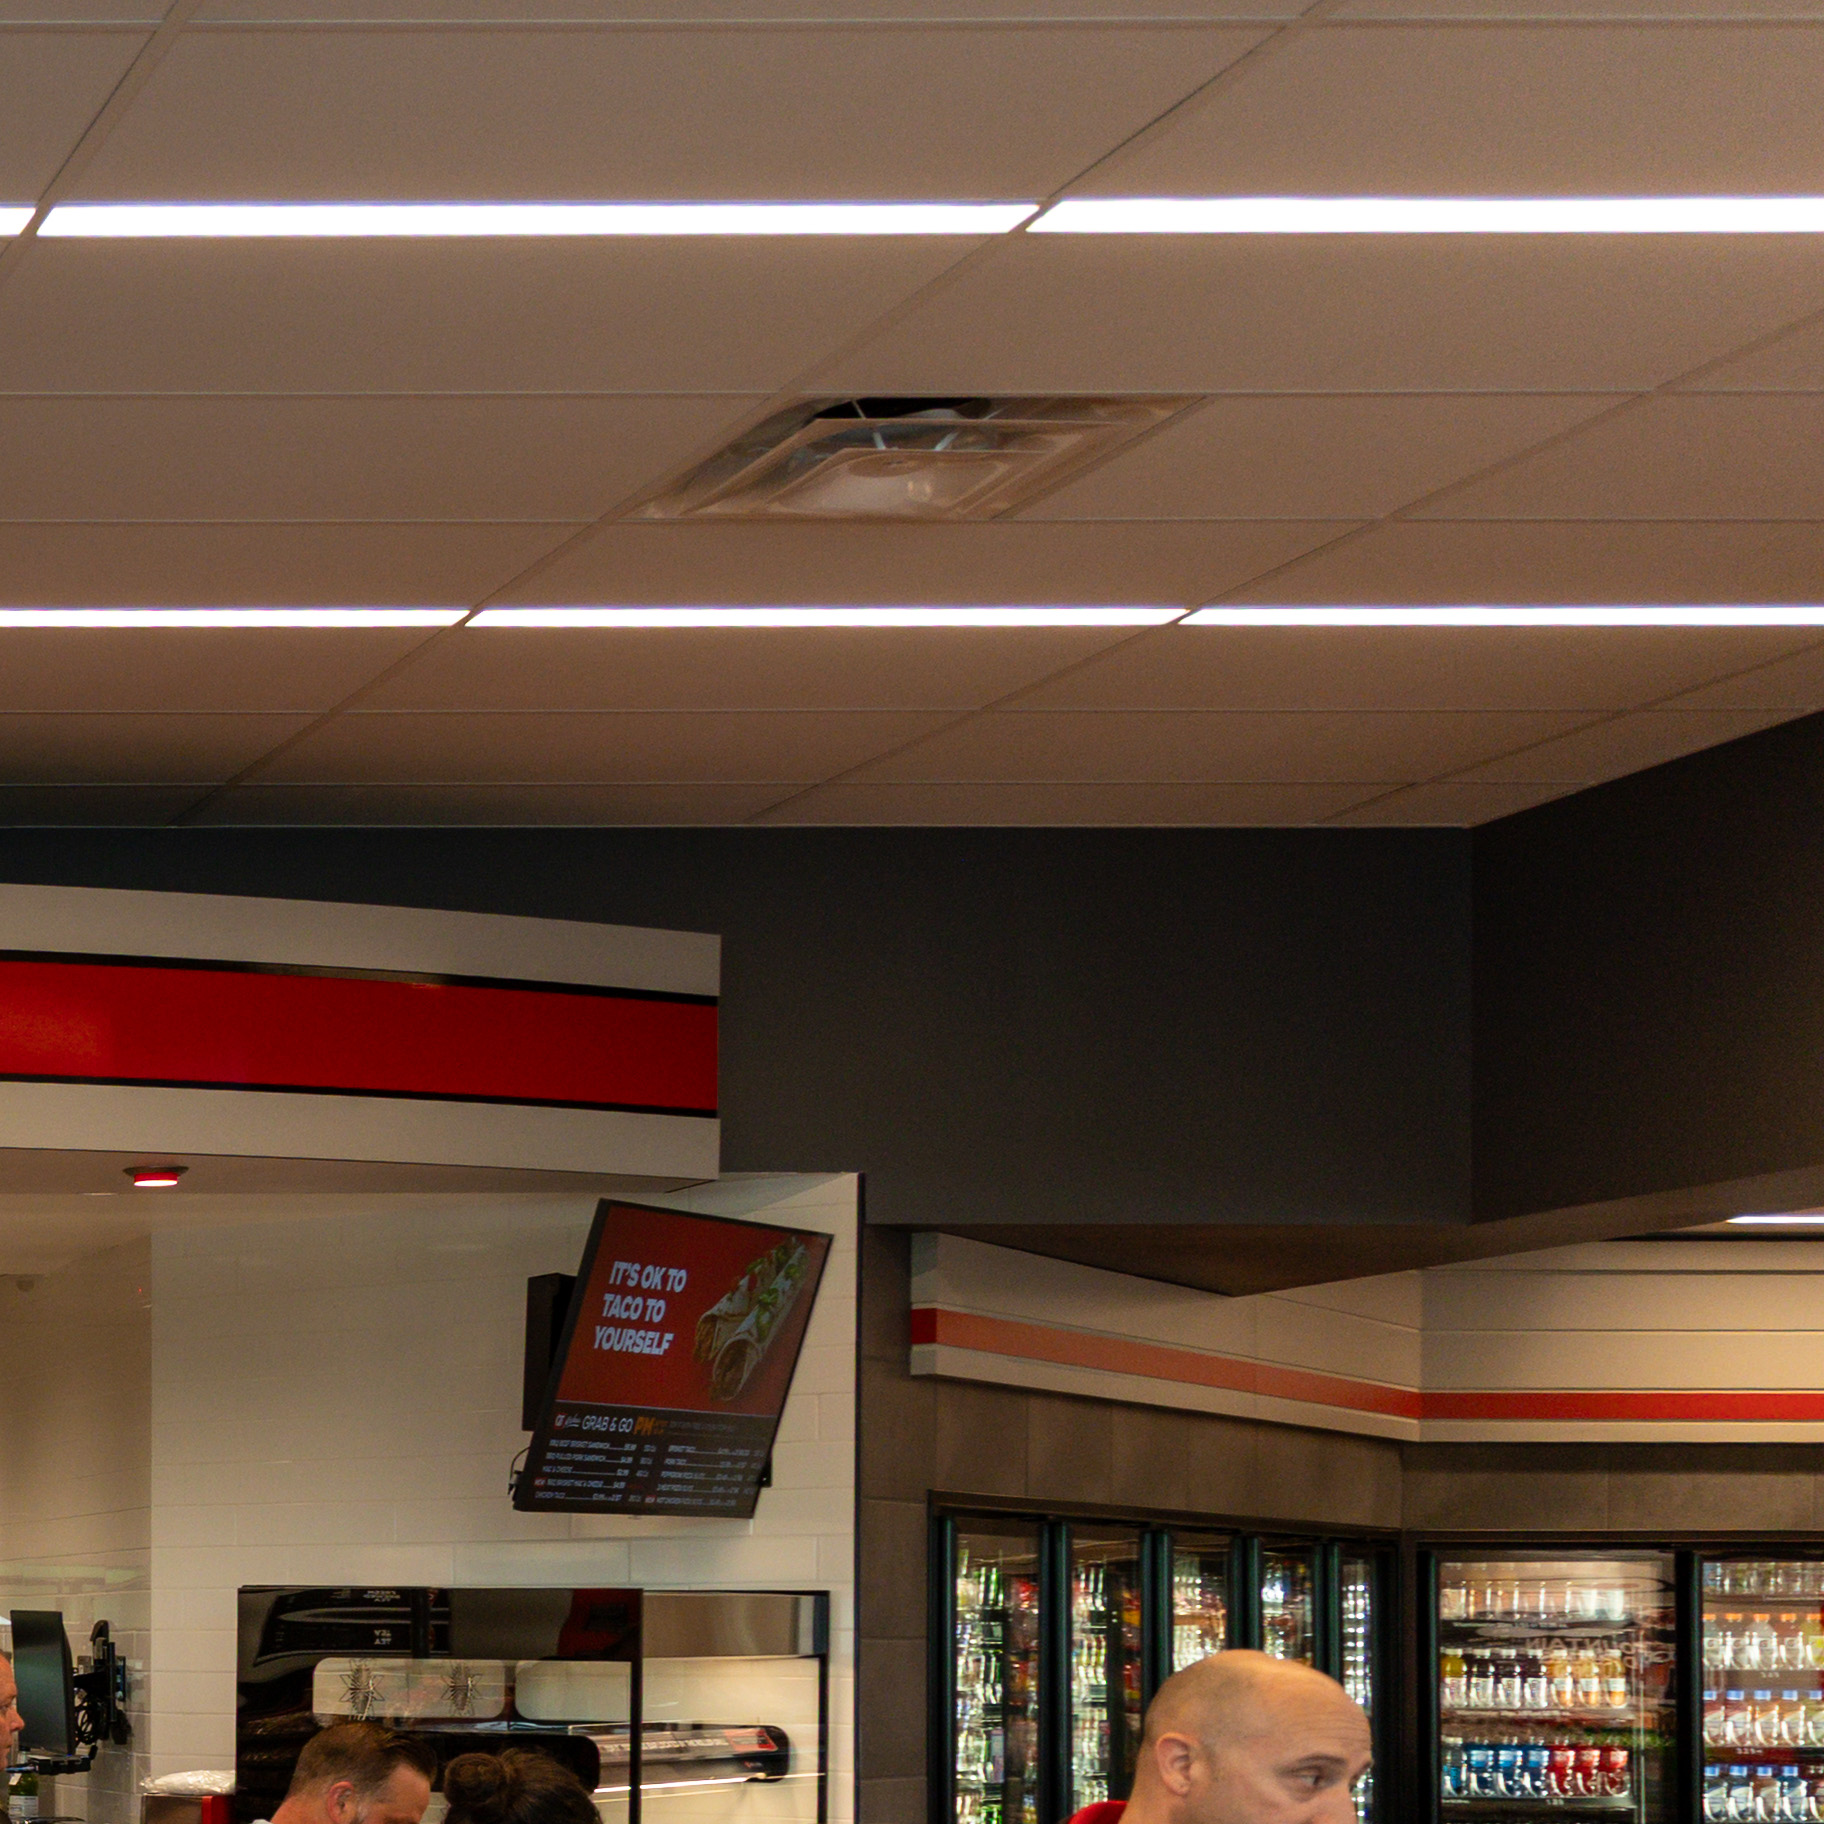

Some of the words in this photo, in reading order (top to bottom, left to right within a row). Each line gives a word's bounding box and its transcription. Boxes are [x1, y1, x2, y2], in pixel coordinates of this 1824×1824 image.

[641, 1266, 663, 1289] OK
[667, 1269, 687, 1293] TO
[602, 1294, 642, 1320] TACO
[645, 1298, 666, 1323] TO
[593, 1326, 674, 1356] YOURSELF
